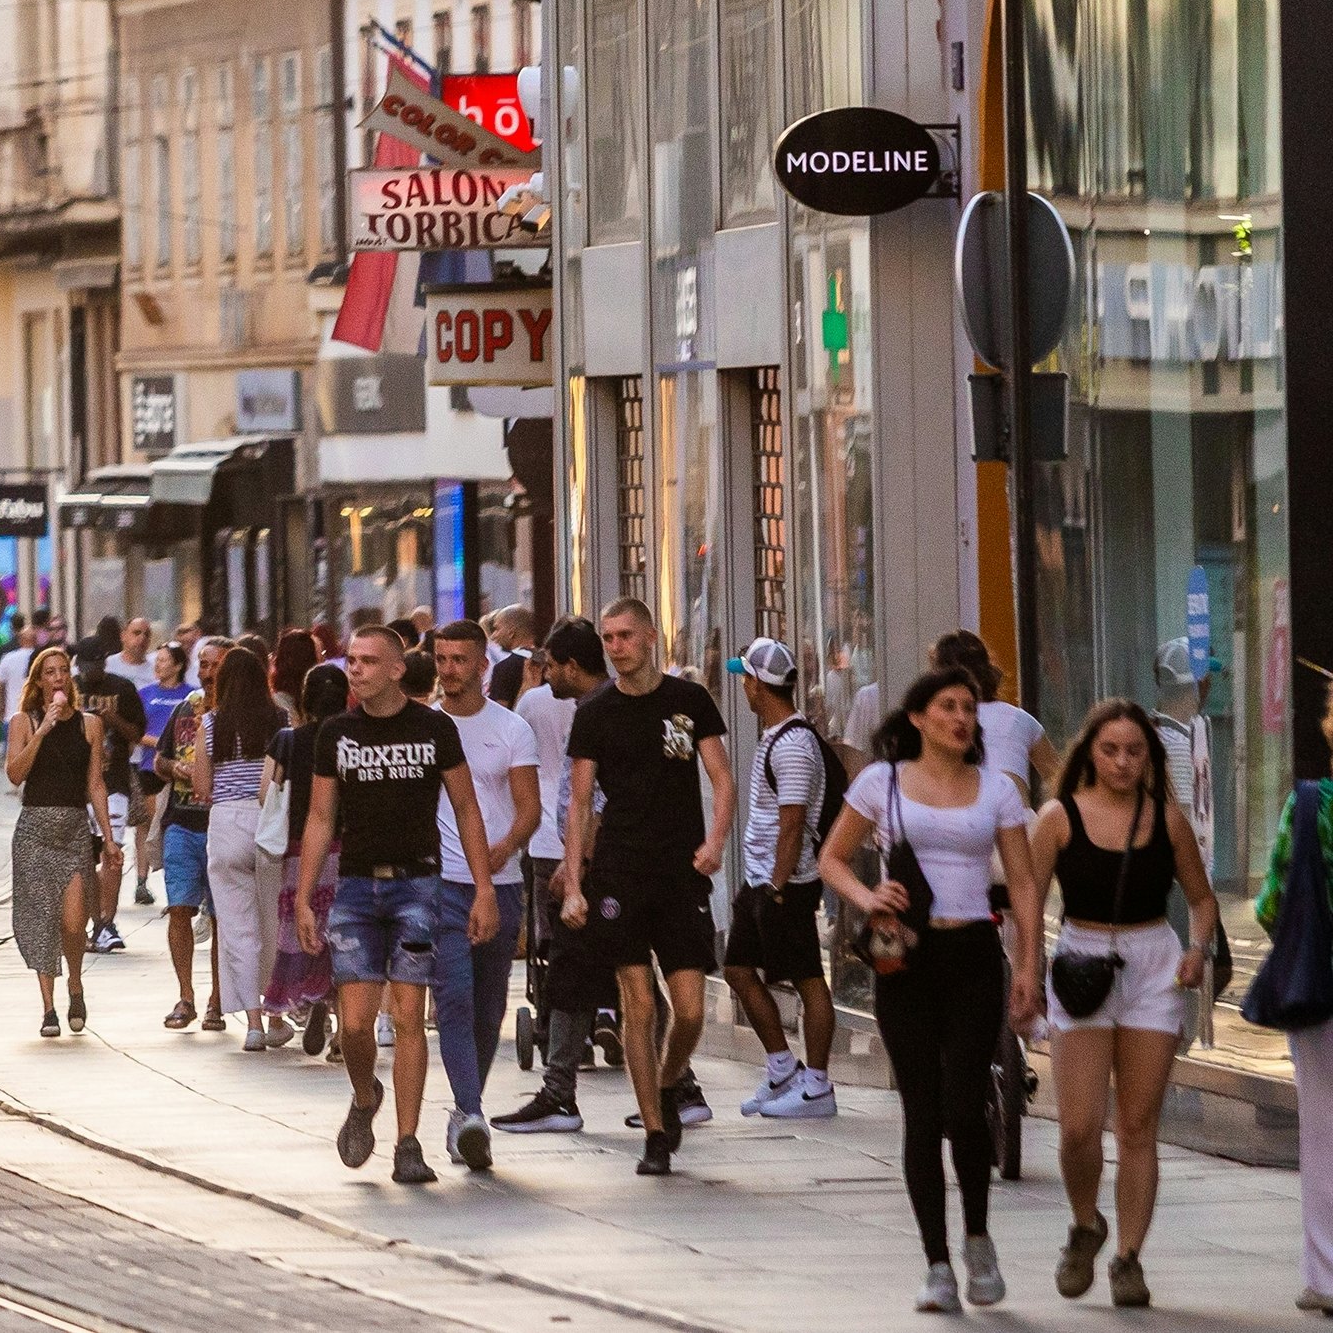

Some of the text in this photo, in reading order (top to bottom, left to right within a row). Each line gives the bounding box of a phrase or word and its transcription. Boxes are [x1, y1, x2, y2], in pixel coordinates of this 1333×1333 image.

[382, 94, 477, 156] COLOR
[786, 150, 929, 174] MODELINE
[381, 169, 506, 209] SALON
[435, 309, 552, 363] COPY
[347, 742, 436, 769] BOXEUR
[358, 765, 425, 782] DES RUES
